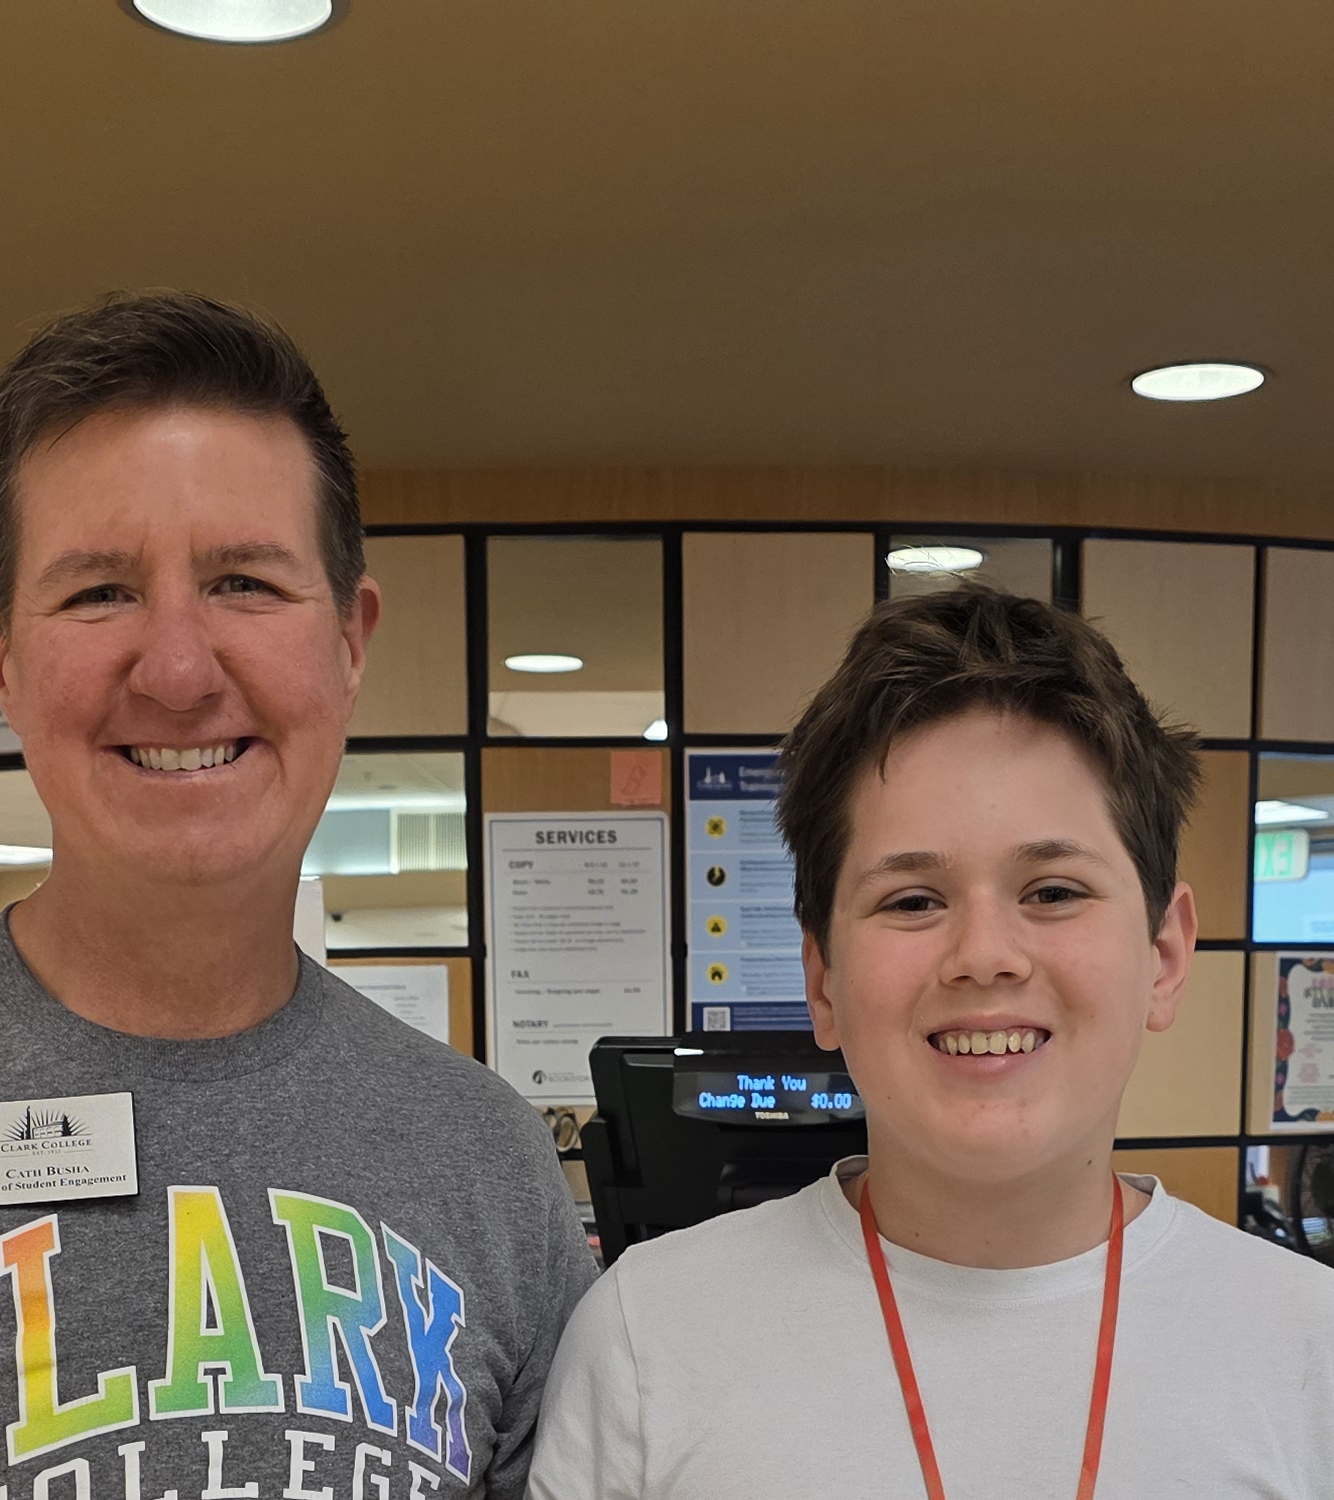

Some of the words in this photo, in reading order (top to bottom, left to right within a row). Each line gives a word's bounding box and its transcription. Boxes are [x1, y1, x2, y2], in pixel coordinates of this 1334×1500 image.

[535, 829, 618, 845] SERVICES
[737, 1075, 775, 1091] Thank
[781, 1075, 807, 1091] You
[698, 1092, 746, 1108] Change
[751, 1093, 776, 1108] Due
[811, 1093, 853, 1109] $0.00
[1, 1142, 38, 1153] CLARK
[41, 1139, 93, 1150] COLLEGE
[2, 1183, 13, 1191] of
[15, 1179, 57, 1191] Student
[60, 1174, 127, 1188] Engagement
